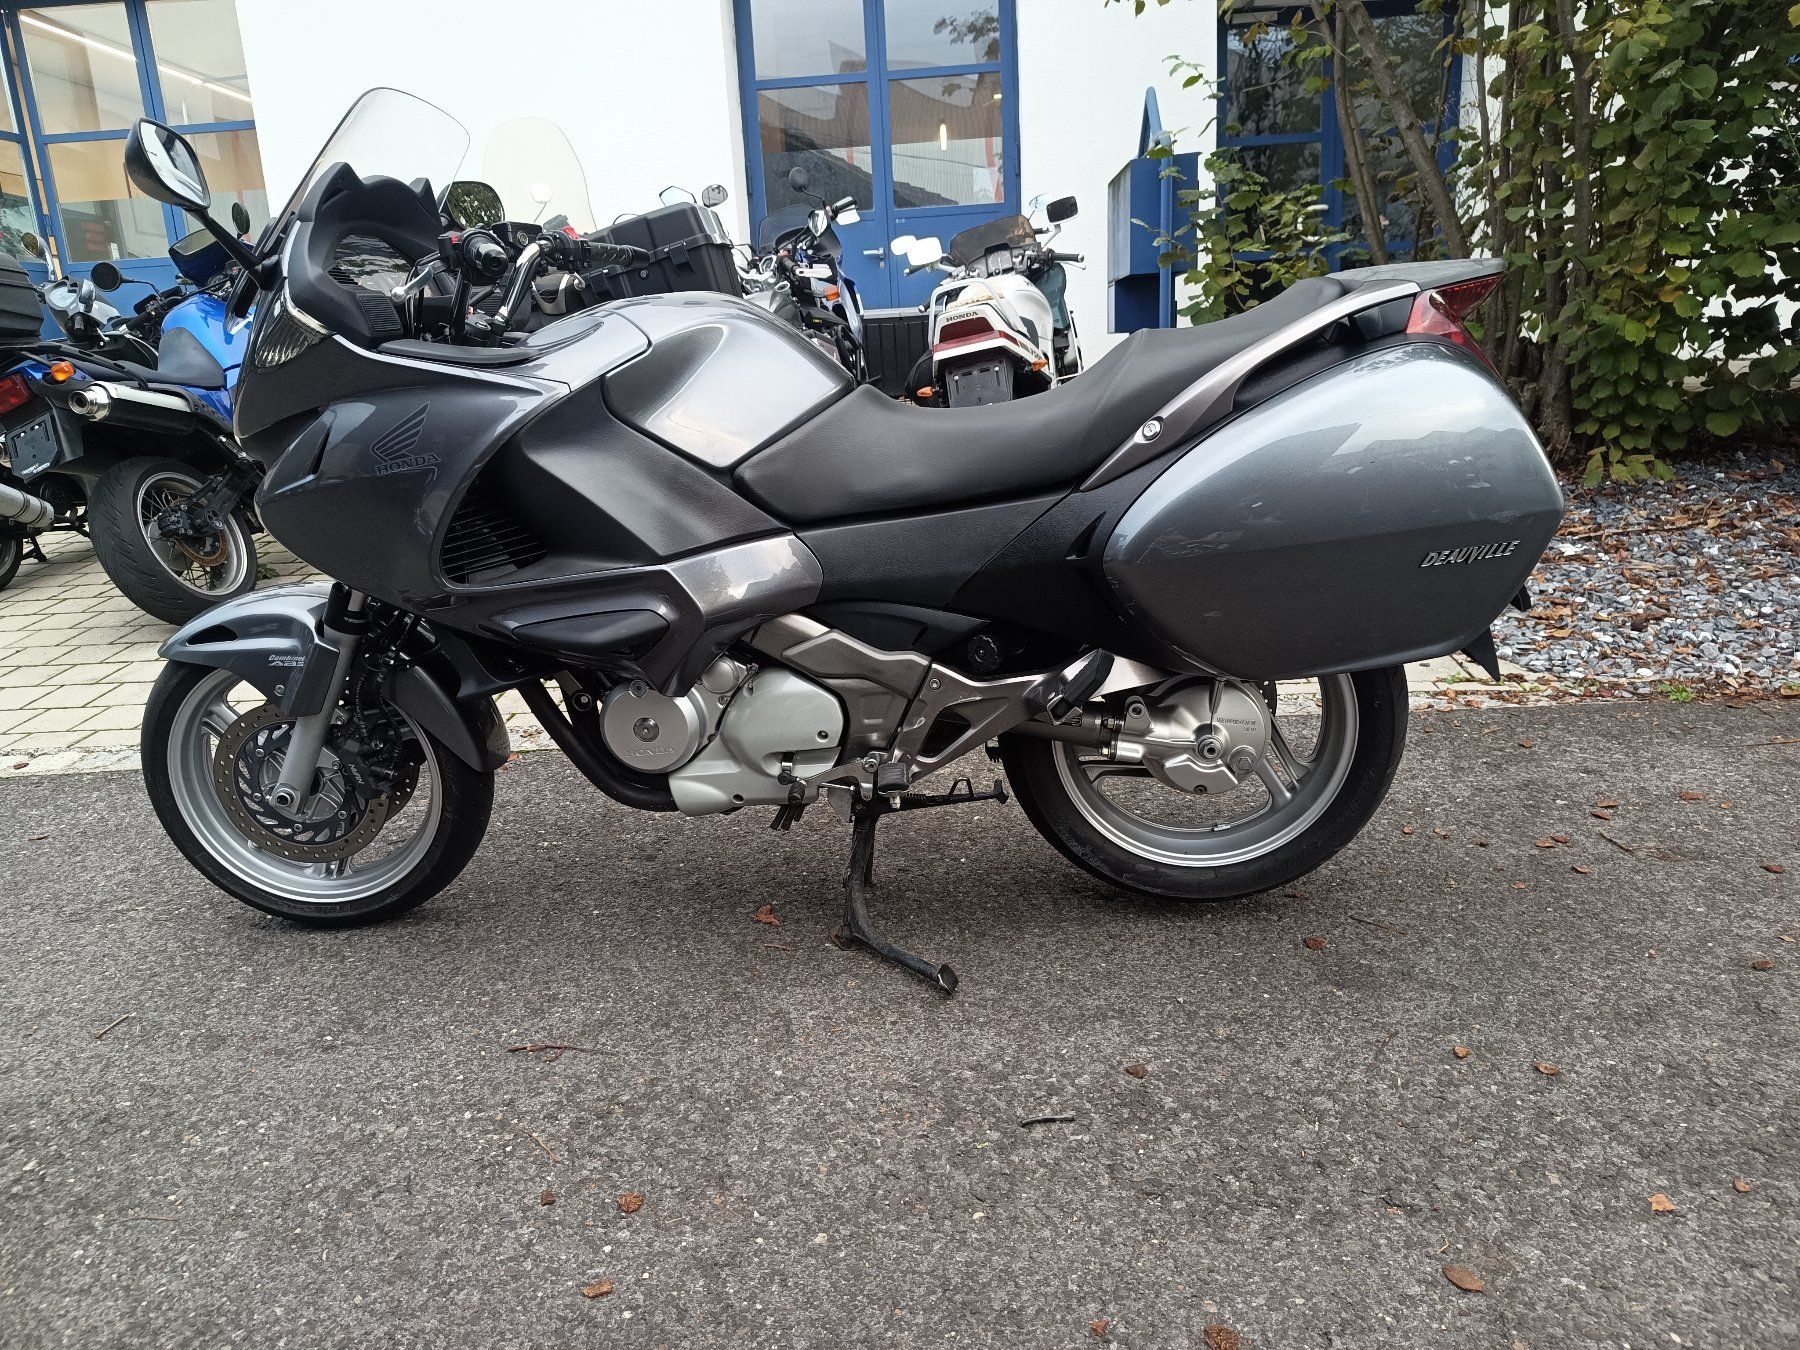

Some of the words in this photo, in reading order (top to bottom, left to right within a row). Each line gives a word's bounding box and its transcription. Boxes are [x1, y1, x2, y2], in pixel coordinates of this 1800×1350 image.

[945, 311, 979, 323] HONDA
[375, 452, 441, 477] HONDA
[1419, 540, 1521, 568] DEAUVILLE
[625, 745, 677, 758] HONDA
